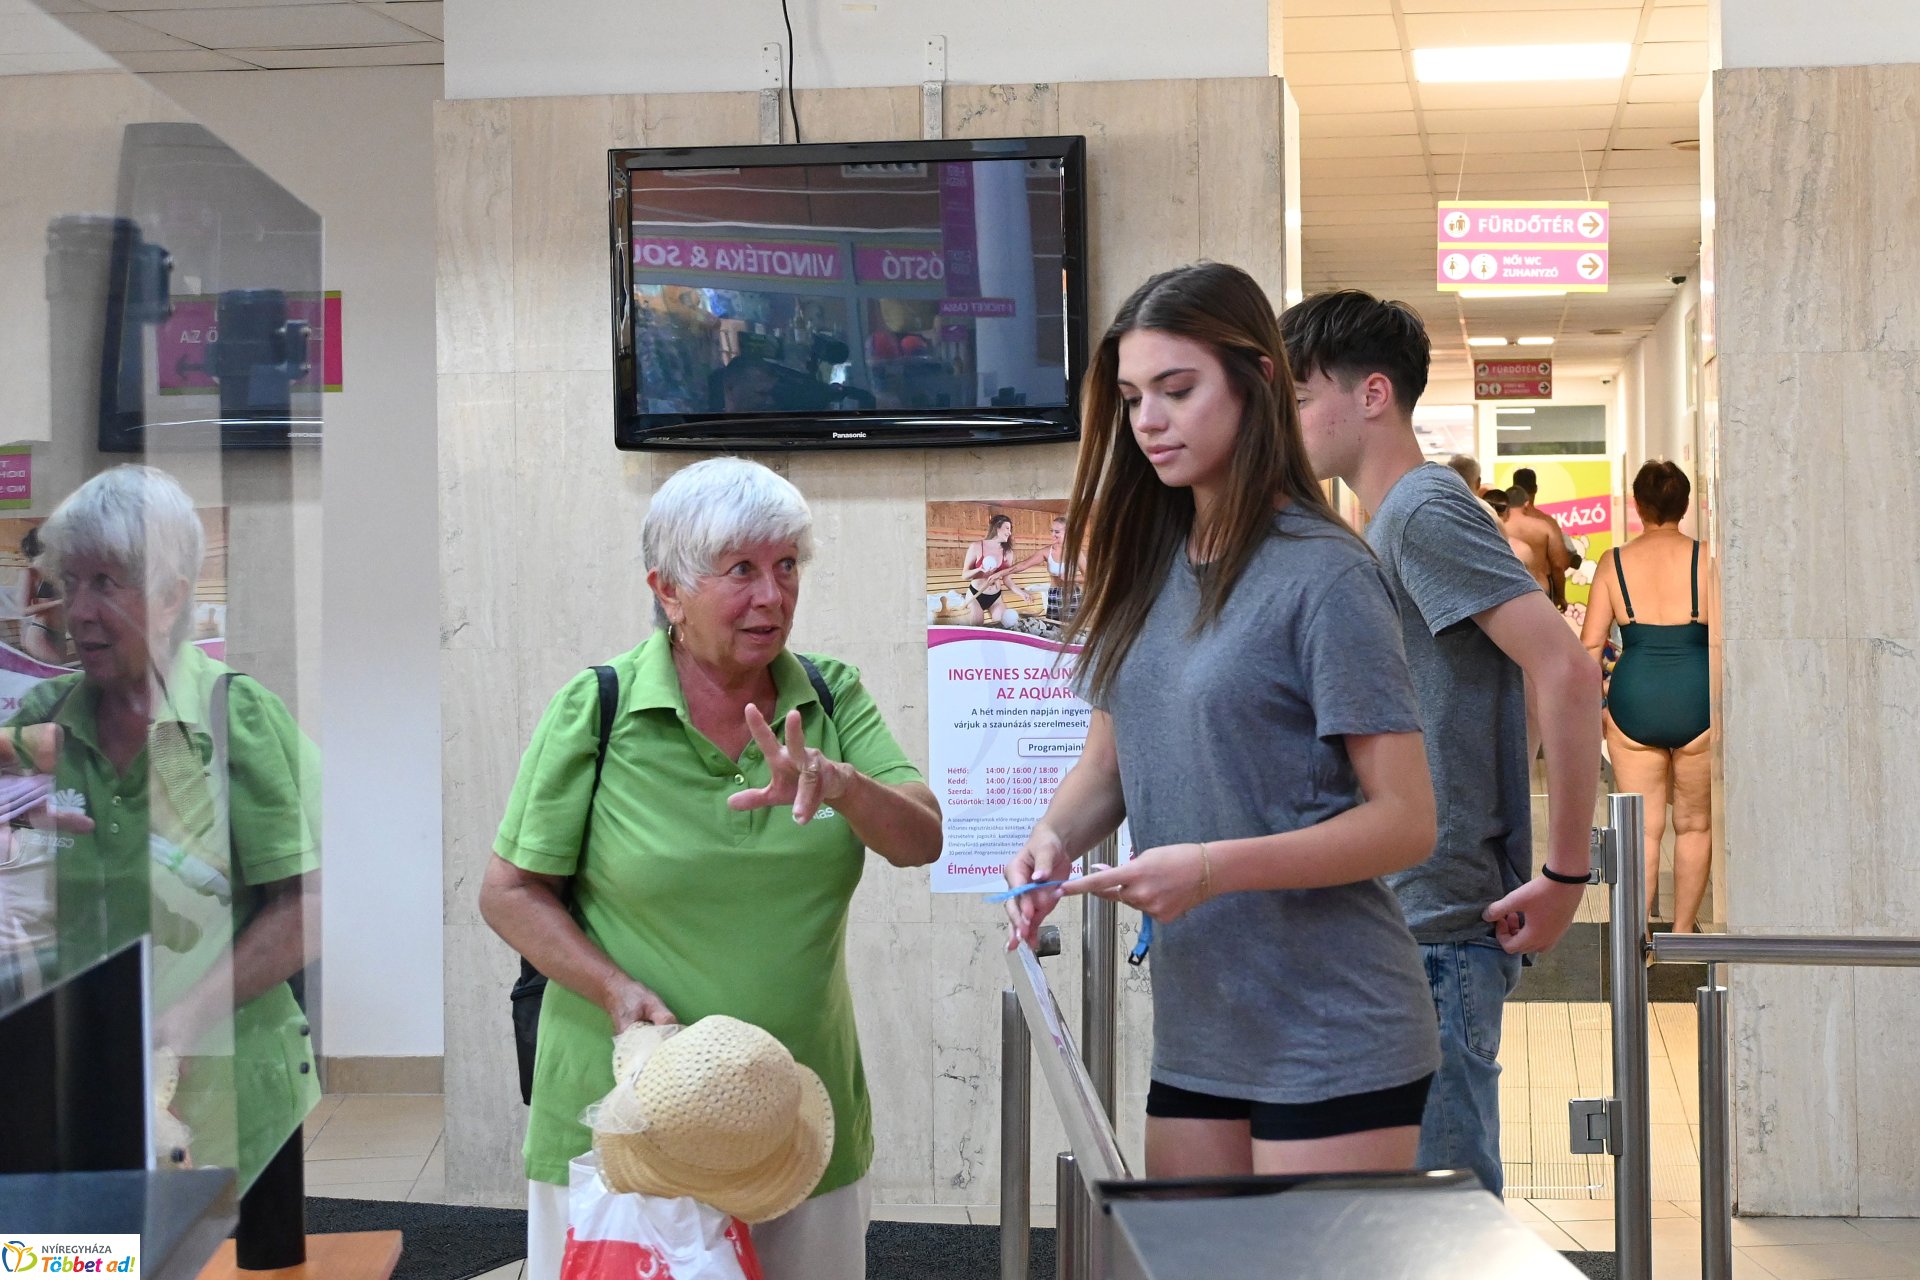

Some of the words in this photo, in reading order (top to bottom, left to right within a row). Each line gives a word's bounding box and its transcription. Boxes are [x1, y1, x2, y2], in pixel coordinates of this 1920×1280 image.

[1478, 215, 1575, 233] FÜRDŐTÉR
[1502, 254, 1523, 265] NŐI
[1524, 256, 1542, 265] WC
[1502, 267, 1559, 278] ZUHANYZÓ
[832, 431, 867, 440] Panasonic
[948, 668, 1020, 681] INGYENES
[1023, 667, 1073, 680] SZAUN
[996, 687, 1015, 699] AZ
[1019, 686, 1075, 701] AQUAR
[971, 708, 978, 716] A
[979, 707, 994, 716] hét
[996, 707, 1028, 716] minden
[1030, 707, 1059, 717] napján
[954, 720, 980, 730] várjuk
[989, 720, 1031, 729] szaunázás
[1033, 719, 1089, 729] szerelmeseit,
[947, 862, 1005, 876] Élményteli
